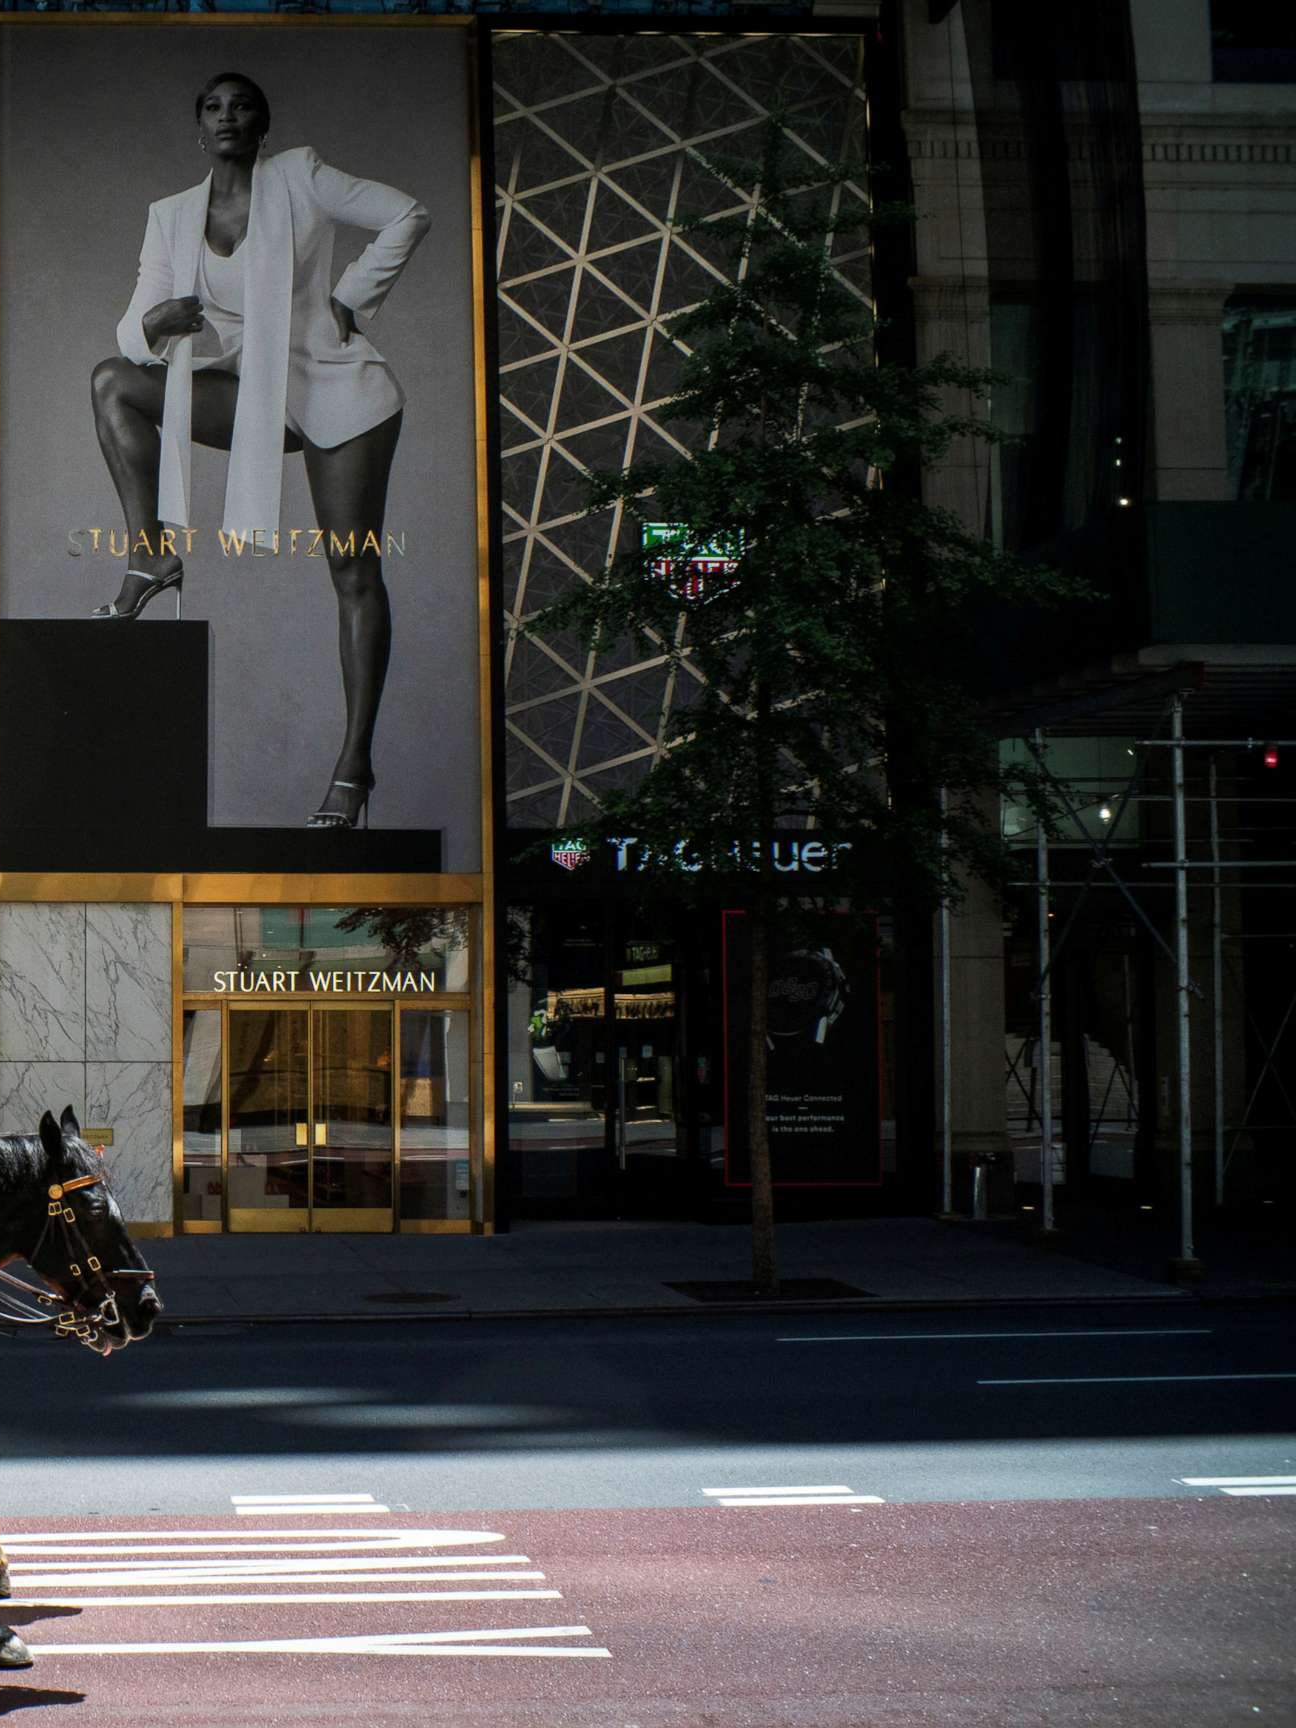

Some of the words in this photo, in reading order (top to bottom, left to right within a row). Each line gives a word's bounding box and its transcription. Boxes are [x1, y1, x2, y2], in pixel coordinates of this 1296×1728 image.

[67, 527, 199, 558] STUART
[217, 527, 406, 558] WEITZMAN
[213, 970, 299, 993] STUART
[309, 970, 436, 993] WEITZMAN
